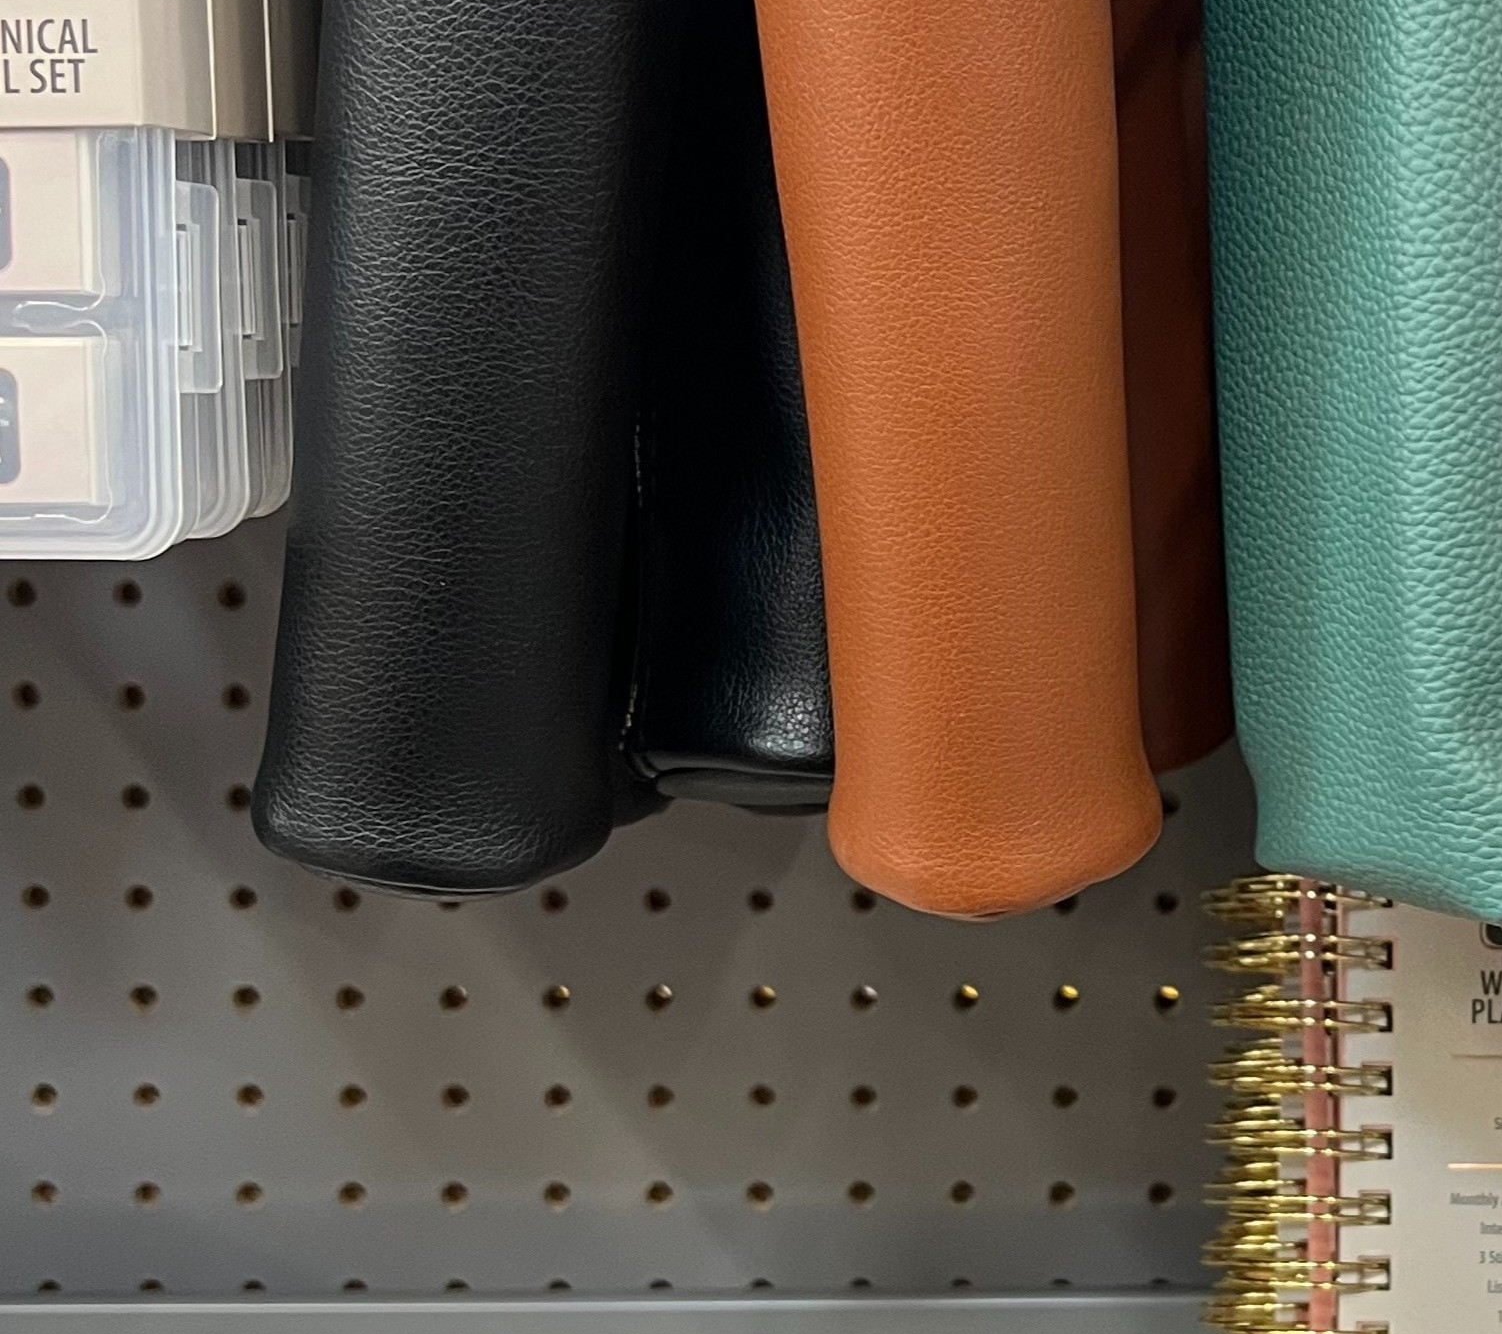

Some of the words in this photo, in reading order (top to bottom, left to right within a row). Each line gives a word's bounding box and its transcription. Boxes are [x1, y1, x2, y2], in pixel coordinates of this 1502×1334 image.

[30, 59, 85, 94] SET
[1450, 1193, 1498, 1208] Monthly
[1479, 1251, 1486, 1264] 3
